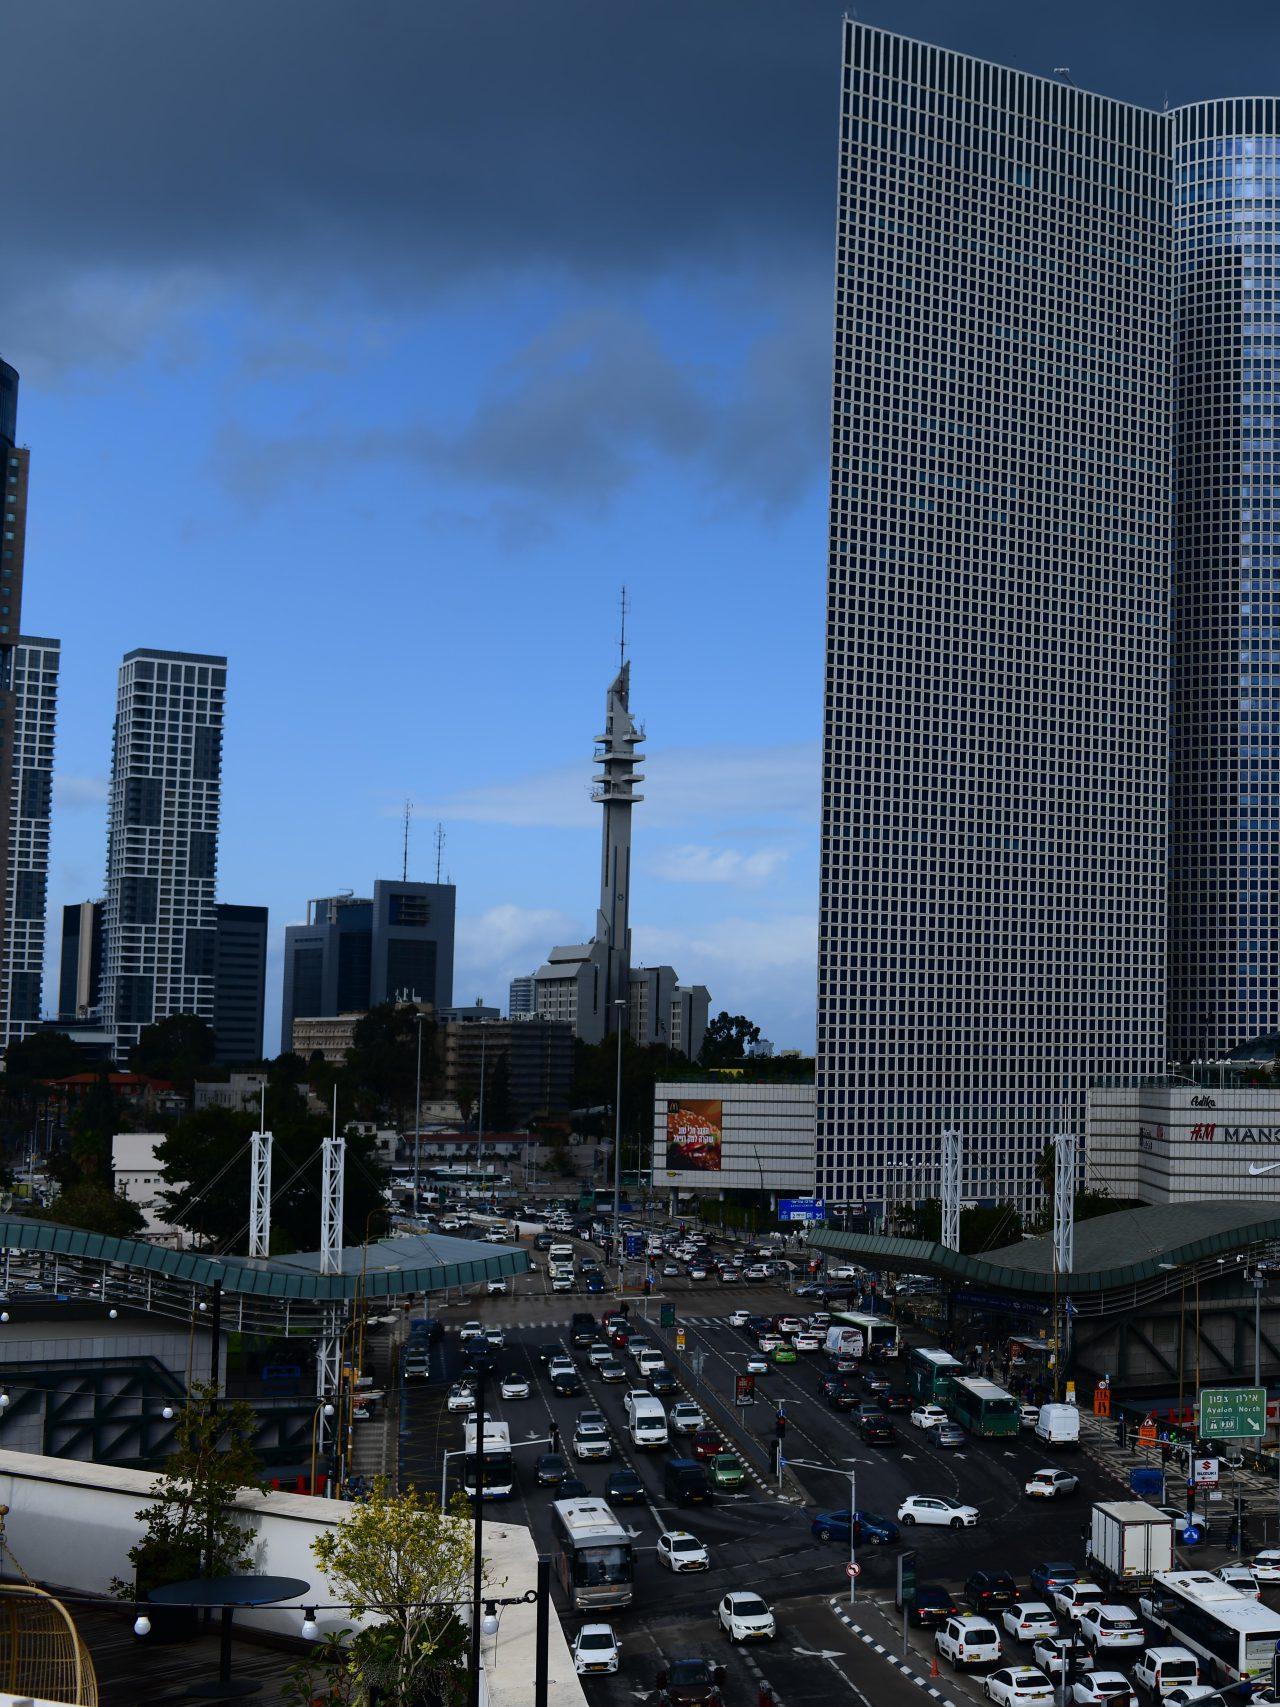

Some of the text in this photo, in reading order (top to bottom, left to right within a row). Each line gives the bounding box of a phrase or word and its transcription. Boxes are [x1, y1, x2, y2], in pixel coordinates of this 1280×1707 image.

[1190, 1095, 1216, 1108] Adika
[1190, 1123, 1216, 1142] H&M
[1209, 1395, 1229, 1404] צפון
